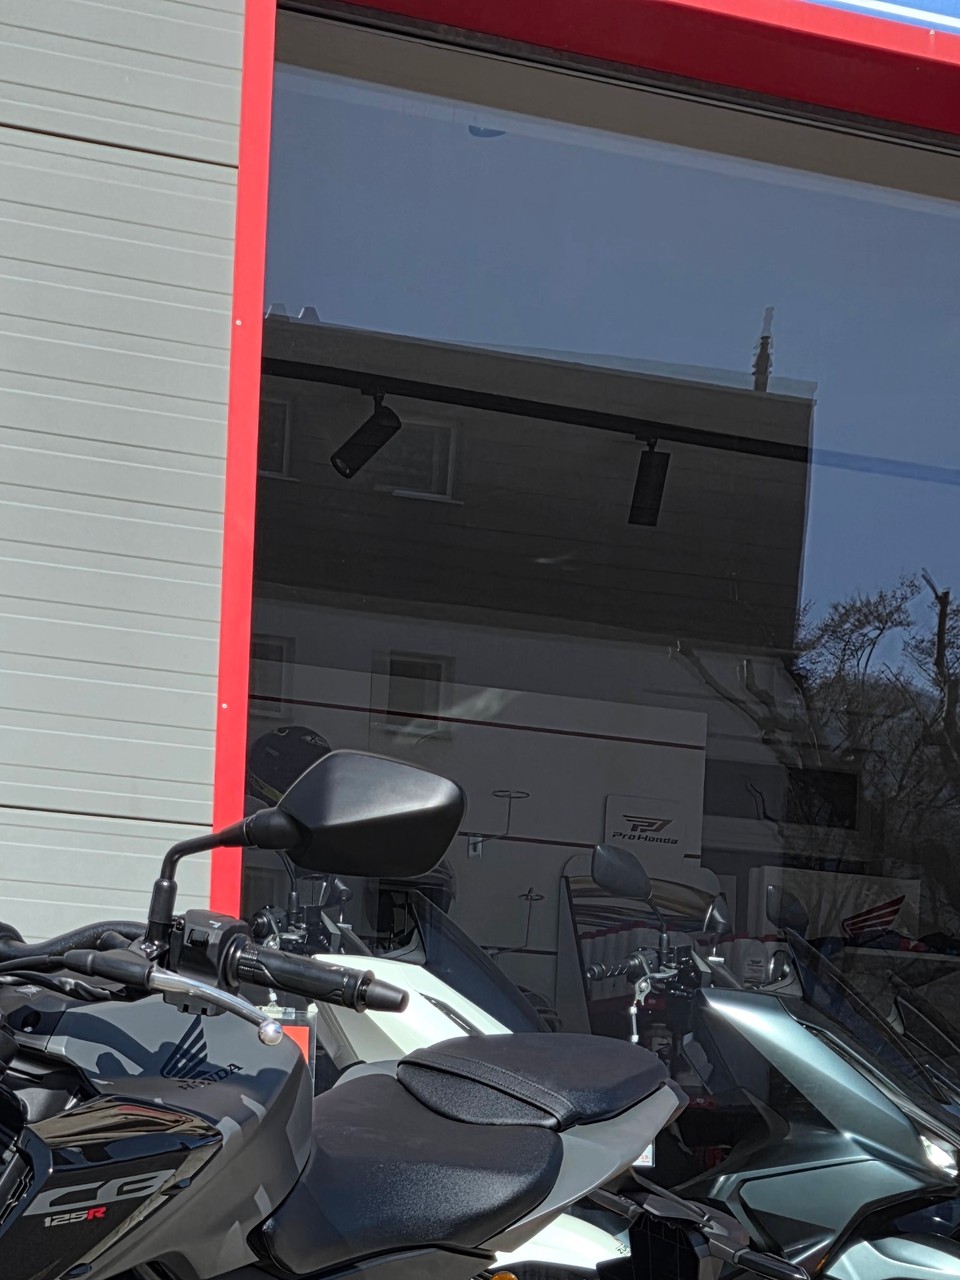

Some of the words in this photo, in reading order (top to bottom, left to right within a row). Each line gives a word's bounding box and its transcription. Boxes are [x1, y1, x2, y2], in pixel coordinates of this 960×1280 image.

[613, 831, 636, 841] Pro
[638, 834, 679, 845] Honda
[178, 1063, 244, 1091] HONDA
[22, 1168, 177, 1217] CB
[44, 1206, 107, 1228] 125R
